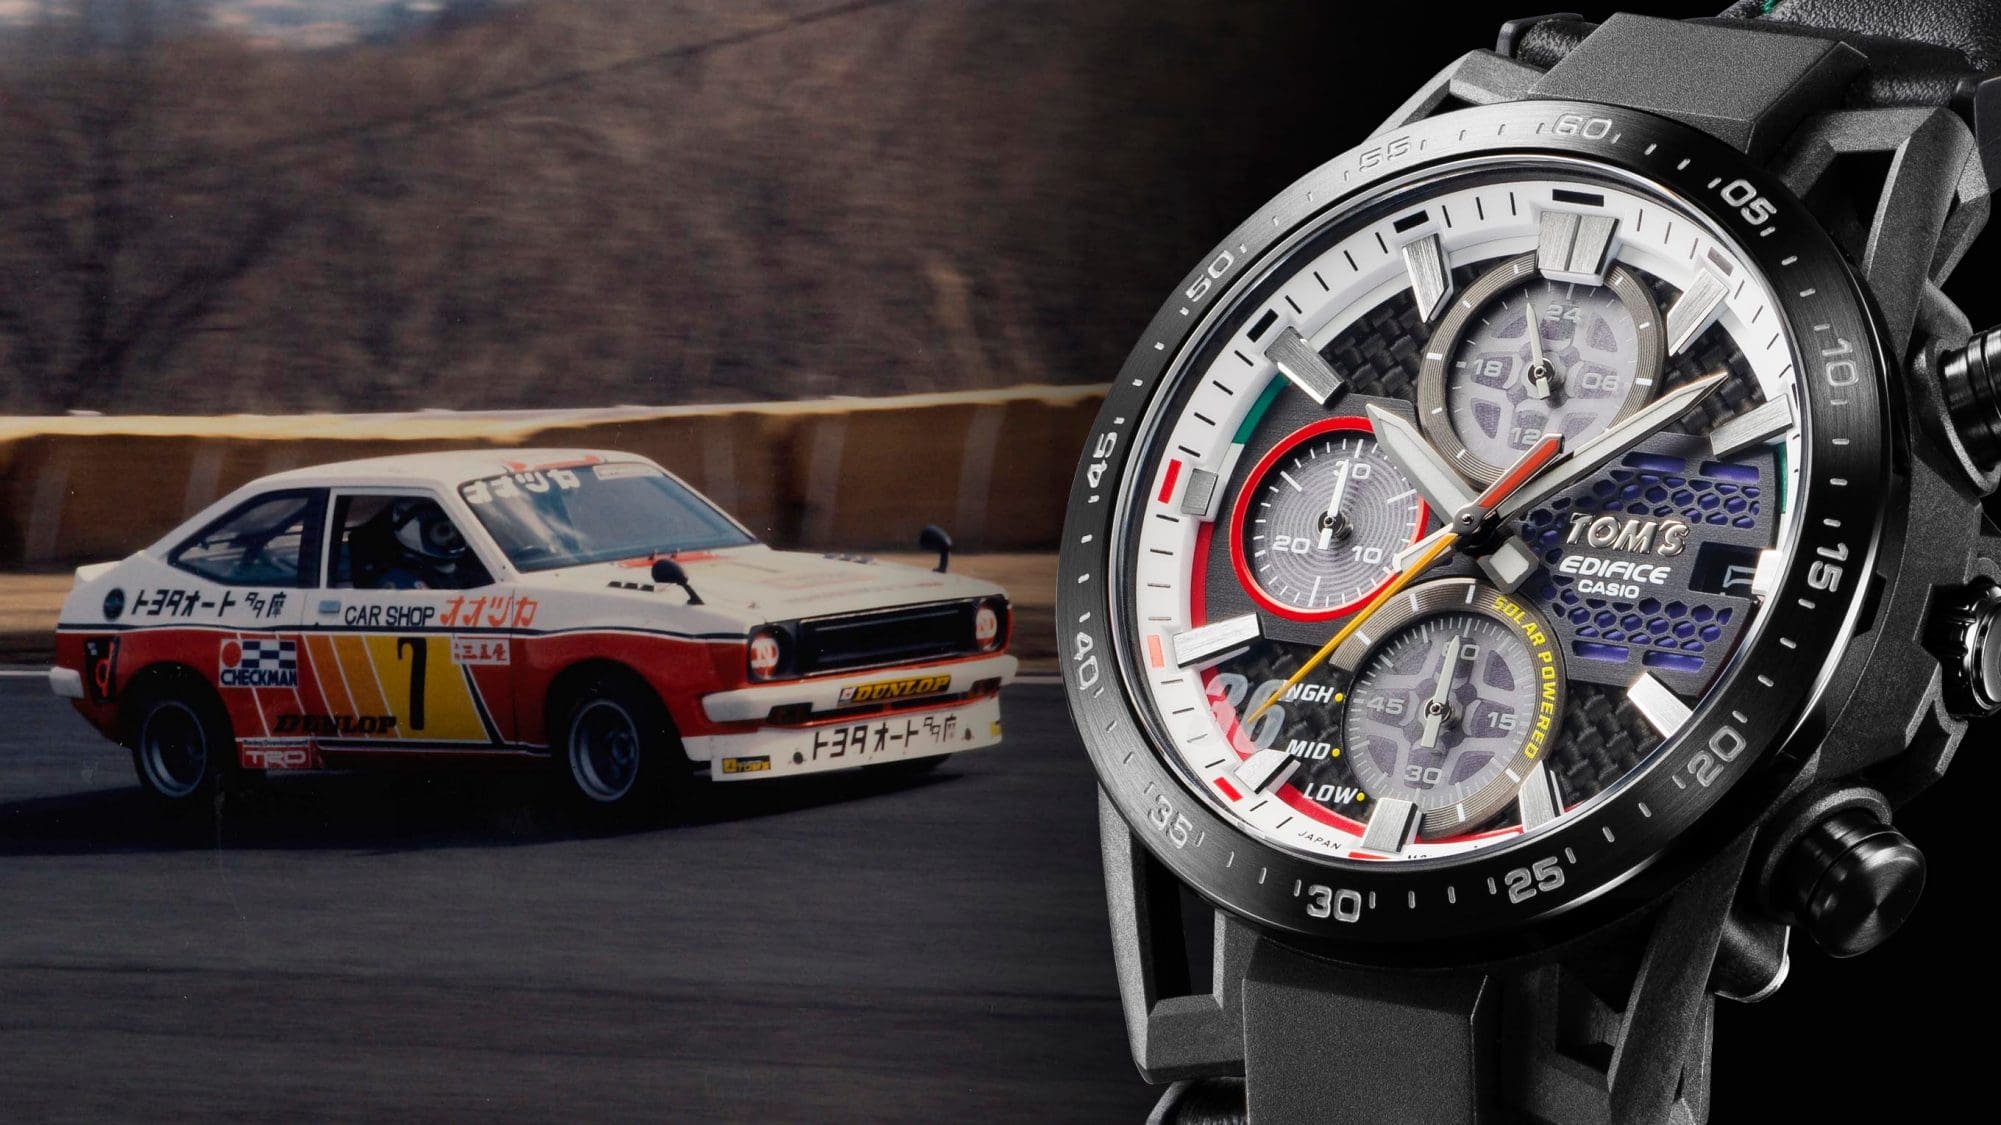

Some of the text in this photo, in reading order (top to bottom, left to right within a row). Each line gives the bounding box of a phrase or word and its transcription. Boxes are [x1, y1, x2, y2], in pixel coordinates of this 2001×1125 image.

[1551, 113, 1612, 139] 60
[1359, 136, 1410, 172] 55
[1720, 178, 1777, 226] 05
[1185, 250, 1234, 302] 50
[1547, 304, 1581, 323] 24
[1472, 359, 1503, 376] 18
[1822, 338, 1859, 386] 10
[1581, 372, 1619, 391] 06
[1087, 432, 1118, 489] 45
[1272, 534, 1311, 554] 20
[1566, 512, 1690, 557] TOM'S
[1352, 546, 1383, 564] 10
[1807, 542, 1849, 593] 15
[1559, 555, 1671, 585] EDIFICE
[1578, 579, 1640, 599] CASIO
[131, 589, 237, 618] トヨタオート
[344, 605, 435, 627] CAR SHOP
[440, 596, 538, 628] オオツカ
[1074, 632, 1099, 690] 40
[221, 669, 298, 686] CHECKMAN
[397, 637, 427, 731] 7
[853, 676, 950, 702] DUNLOP
[1491, 596, 1557, 759] SOLAR POWERED
[1367, 696, 1405, 715] 45
[274, 715, 397, 734] DUNLOP
[1487, 712, 1518, 731] 15
[813, 719, 918, 760] トヨタオート
[1286, 739, 1331, 760] MID
[245, 750, 307, 769] TRD
[1687, 725, 1746, 787] 20
[1404, 765, 1443, 784] 30
[1302, 782, 1358, 805] LOW
[1148, 794, 1193, 849] 35
[1298, 830, 1342, 850] JAPAN
[1504, 856, 1565, 904] 25
[1306, 884, 1362, 923] 30
